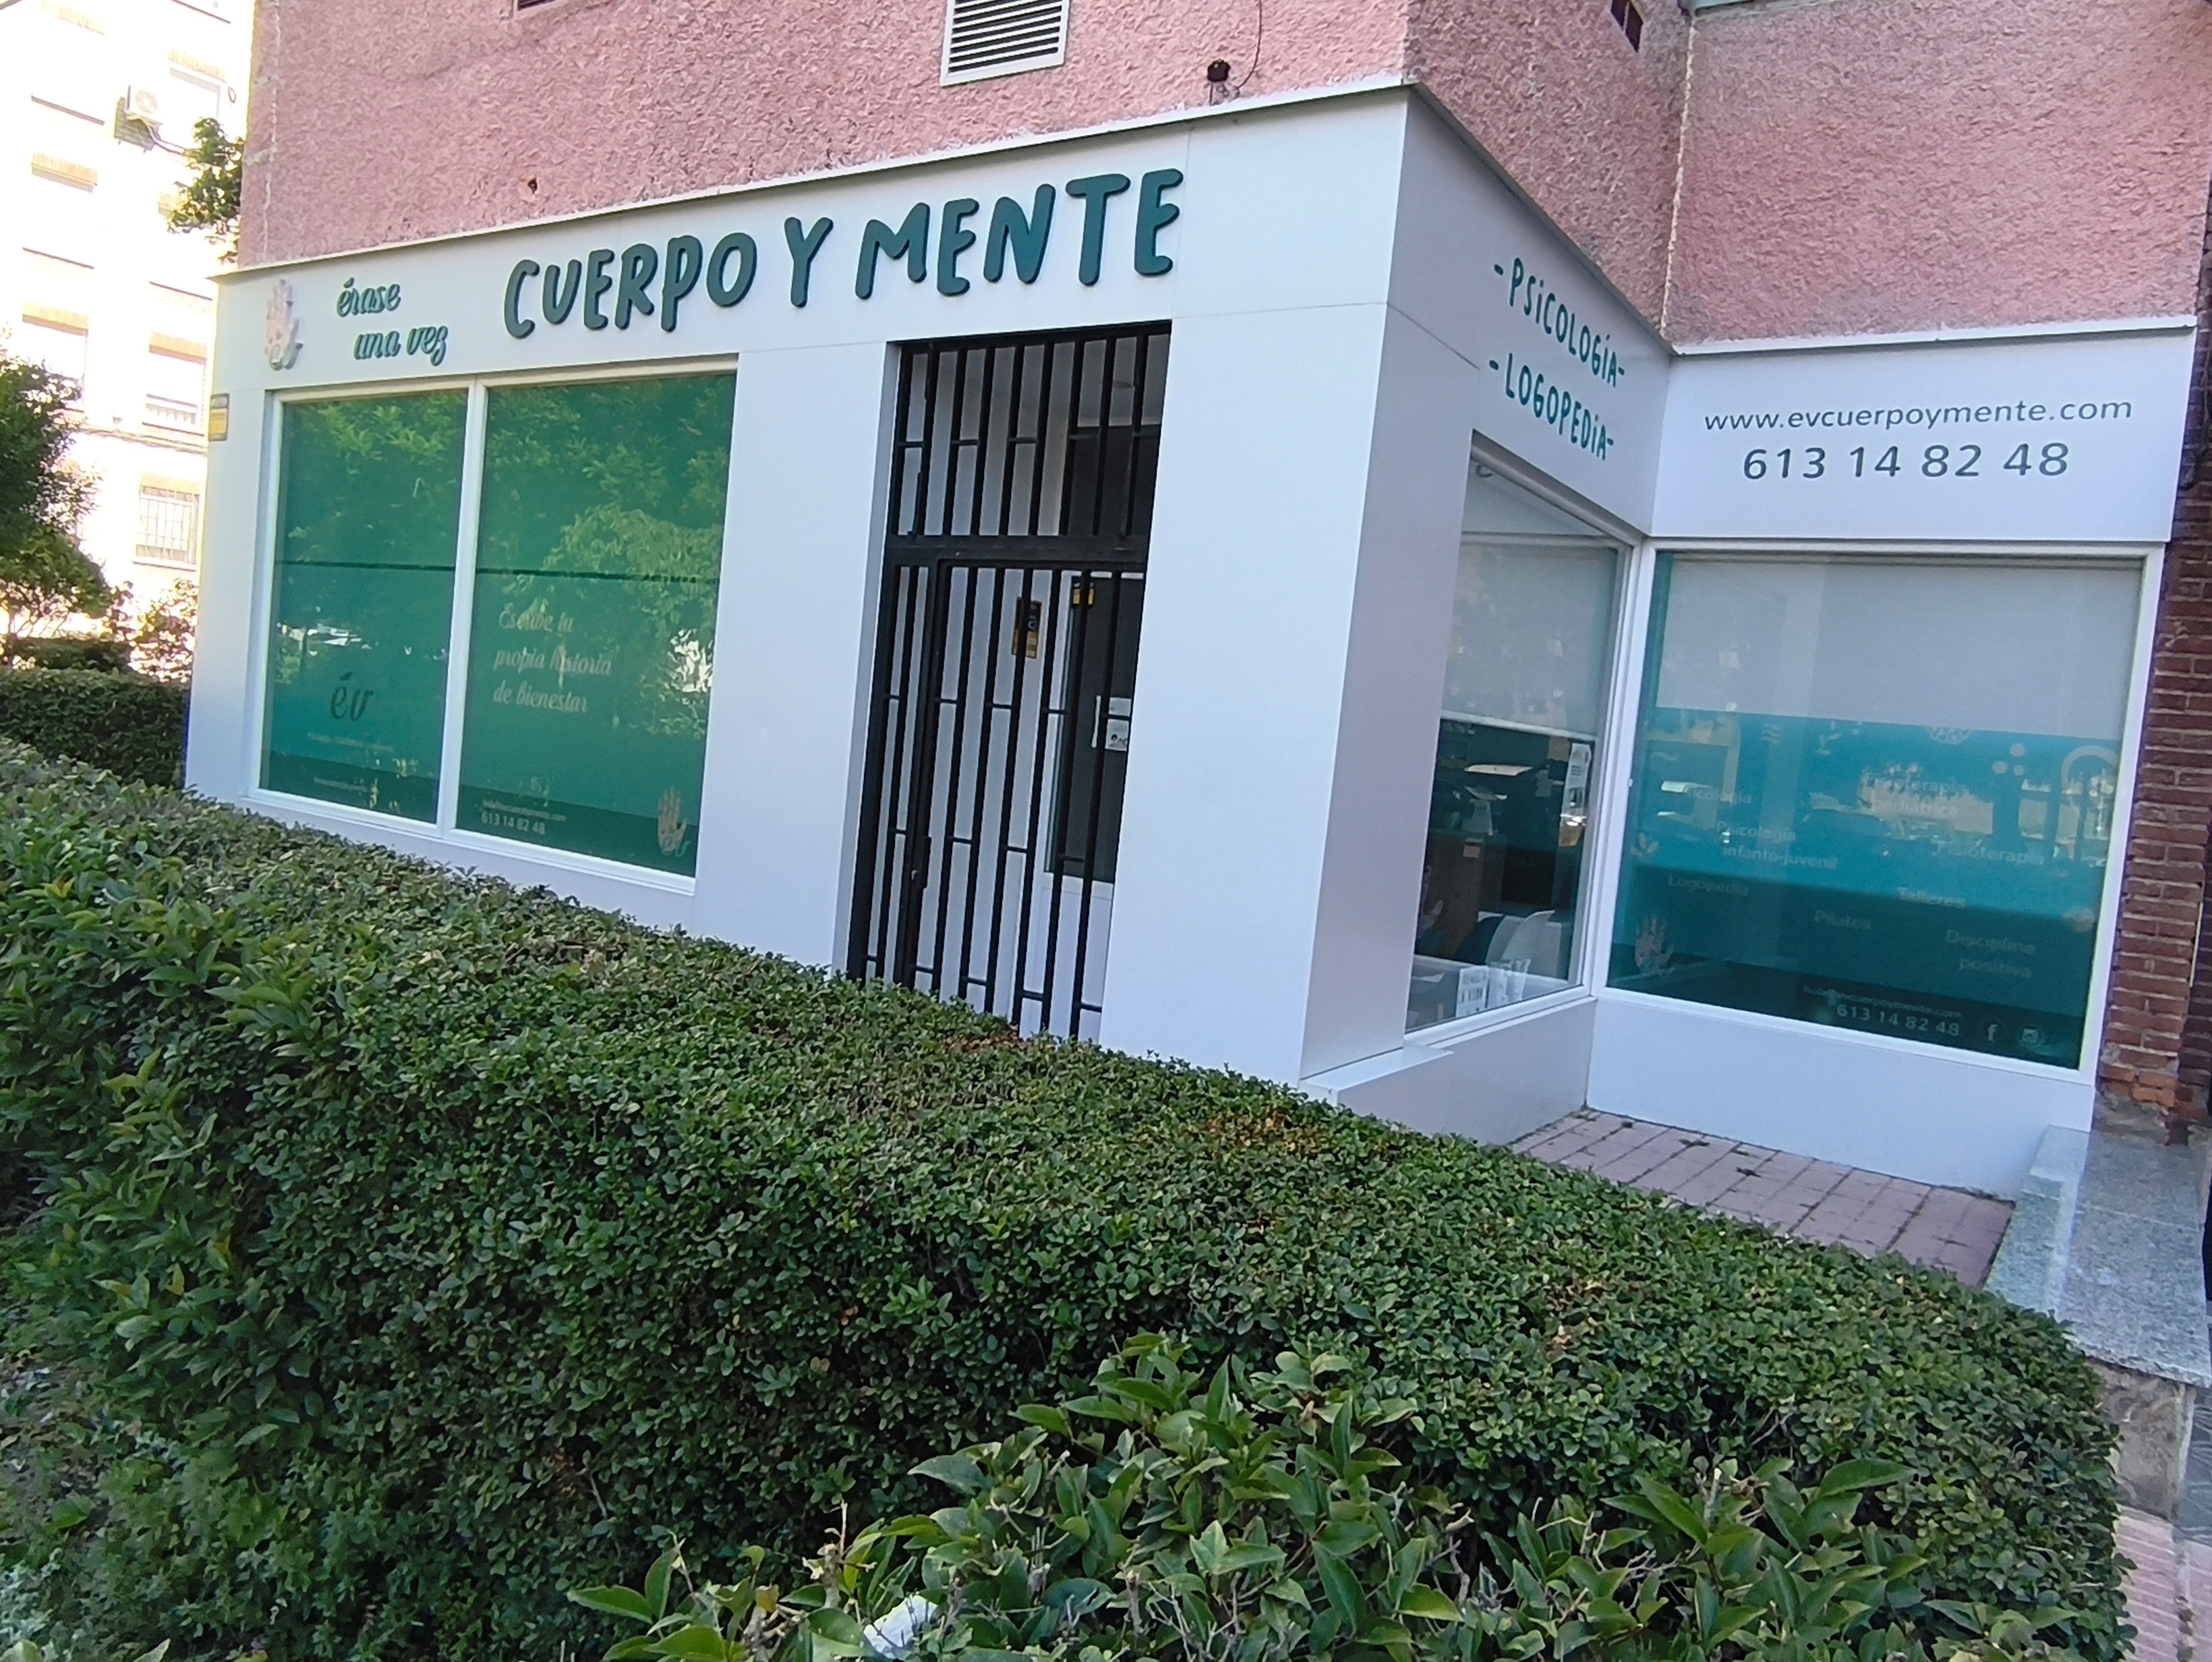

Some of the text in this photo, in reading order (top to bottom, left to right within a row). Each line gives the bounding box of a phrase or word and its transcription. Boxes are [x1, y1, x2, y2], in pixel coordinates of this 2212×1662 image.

[504, 167, 1184, 339] CUERPO Y MENTE
[337, 277, 402, 318] érase
[353, 325, 449, 367] una vez
[1704, 400, 2132, 430] www.evcuerpoymente.com
[1743, 442, 2070, 480] 613 14 82 48
[557, 611, 575, 633] la
[493, 647, 545, 674] propia
[492, 679, 589, 713] de bienestar
[482, 810, 500, 826] 613
[503, 815, 515, 828] 14
[517, 818, 529, 832] 82
[531, 821, 546, 835] 48
[1668, 873, 1749, 896] Logopedia
[1836, 1003, 1960, 1037] 613 14 82 48
